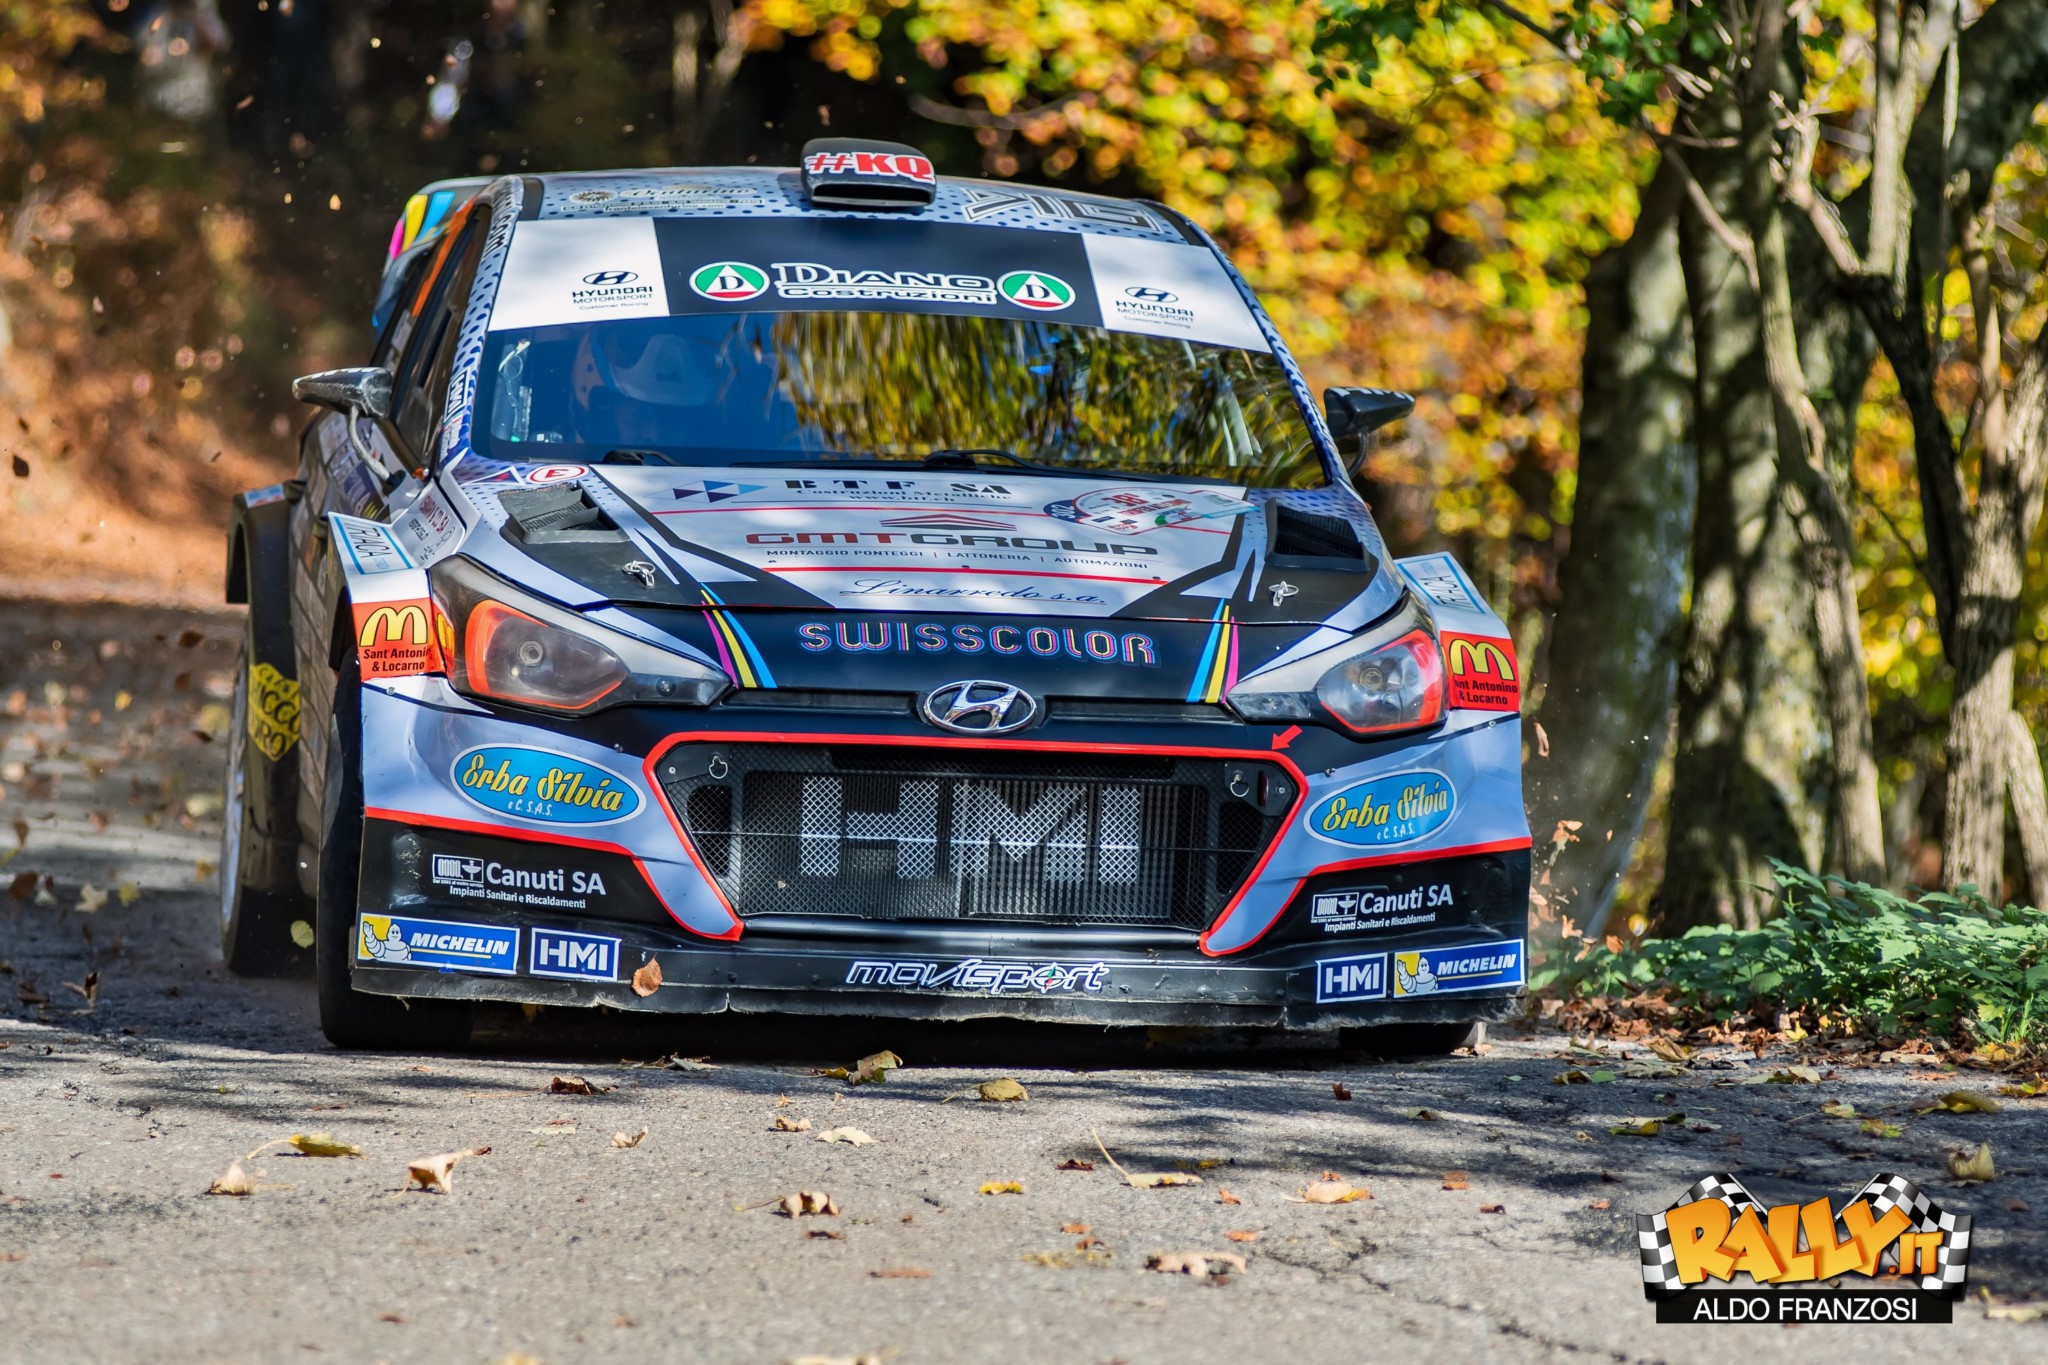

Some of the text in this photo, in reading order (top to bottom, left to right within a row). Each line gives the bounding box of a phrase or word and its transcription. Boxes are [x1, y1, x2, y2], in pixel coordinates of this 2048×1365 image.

[806, 153, 935, 182] #KQ
[572, 286, 653, 298] HYUNDAI
[573, 294, 653, 304] MOTORSPORT
[783, 287, 994, 303] Costruzioni
[1116, 300, 1194, 317] HYUNDAI
[1118, 308, 1195, 322] MOTORSPORT
[545, 469, 569, 479] E
[914, 490, 1012, 500] Metalliche
[950, 483, 1012, 494] SA
[947, 552, 1031, 561] LATTONERIA
[1054, 557, 1148, 569] AUTOMAZIONI
[839, 579, 1106, 603] Linarredo s.a.
[798, 622, 1158, 665] SWISSCOLOR
[372, 661, 425, 672] & Locarno
[1472, 680, 1518, 693] Antonino
[1458, 691, 1508, 705] & Locarno
[462, 753, 625, 812] Erba Silvia
[526, 801, 553, 817] S.A.S.
[1322, 779, 1448, 832] Erba Silvia
[799, 776, 1140, 884] HMI
[1393, 822, 1415, 838] S.A.S.
[486, 862, 607, 895] Canuti SA
[450, 885, 485, 898] Impianti
[486, 889, 518, 901] Sanitari
[525, 894, 586, 909] Riscaldamenti
[1360, 884, 1454, 914] Canuti SA
[1324, 921, 1356, 933] Impianti
[1356, 918, 1384, 930] Sanitari
[1391, 912, 1436, 927] Riscaldamenti
[410, 932, 510, 956] MICHELIN
[538, 938, 609, 971] HMI
[1437, 953, 1517, 976] MICHELIN
[1325, 963, 1379, 993] HMI
